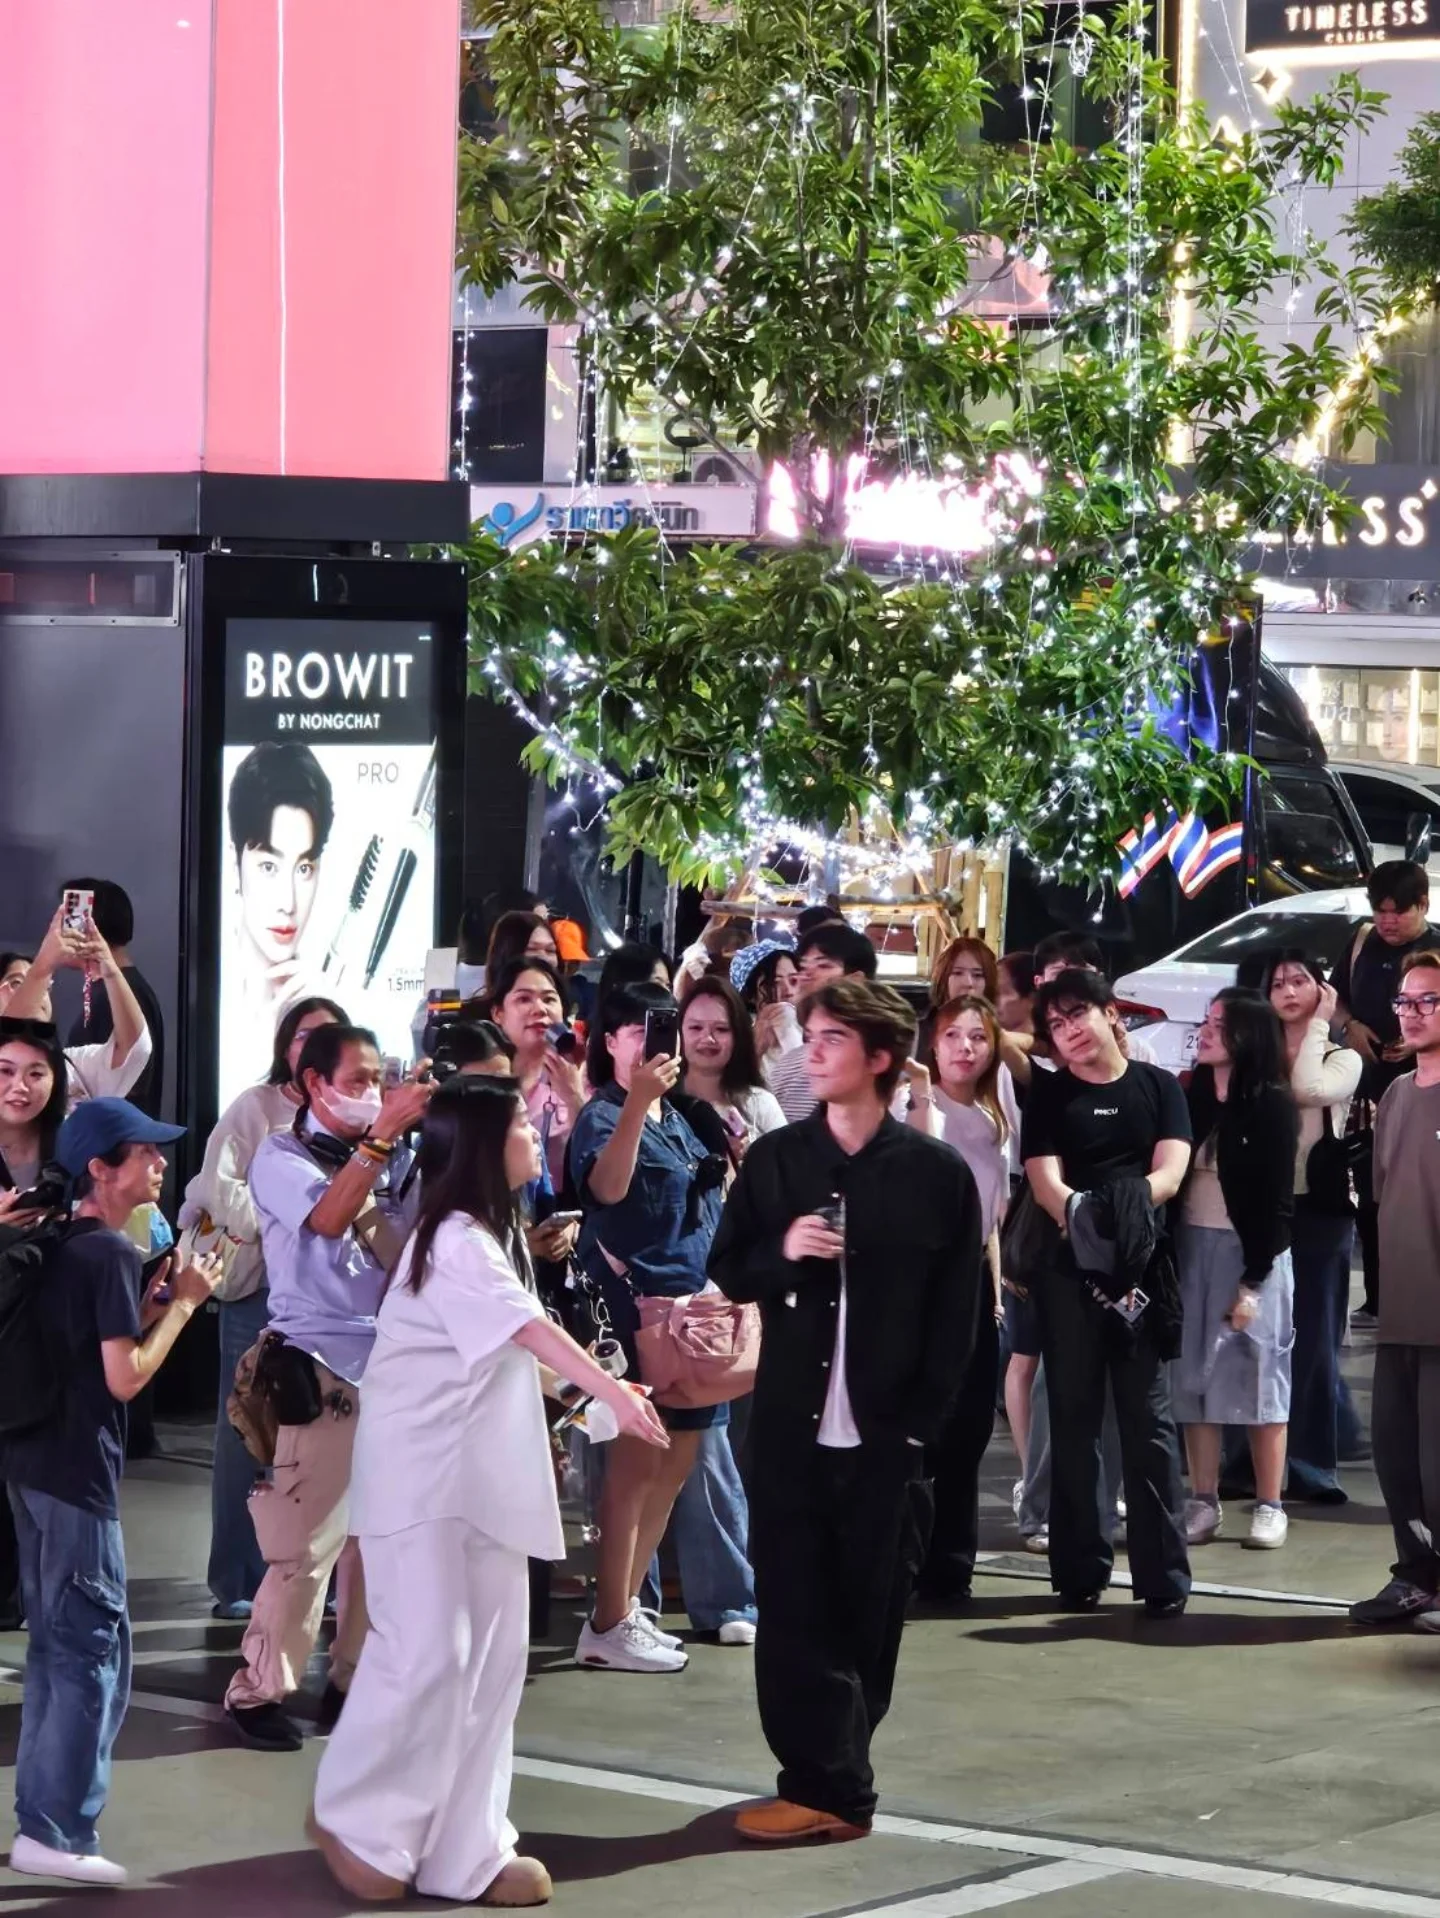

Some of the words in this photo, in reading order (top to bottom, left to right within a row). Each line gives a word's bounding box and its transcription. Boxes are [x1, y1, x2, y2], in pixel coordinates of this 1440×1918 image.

[1285, 0, 1428, 31] TIMELESS
[245, 652, 413, 699] BROWIT
[278, 714, 295, 730] BY
[300, 713, 380, 730] NONGCHAT
[358, 762, 399, 783] PRO
